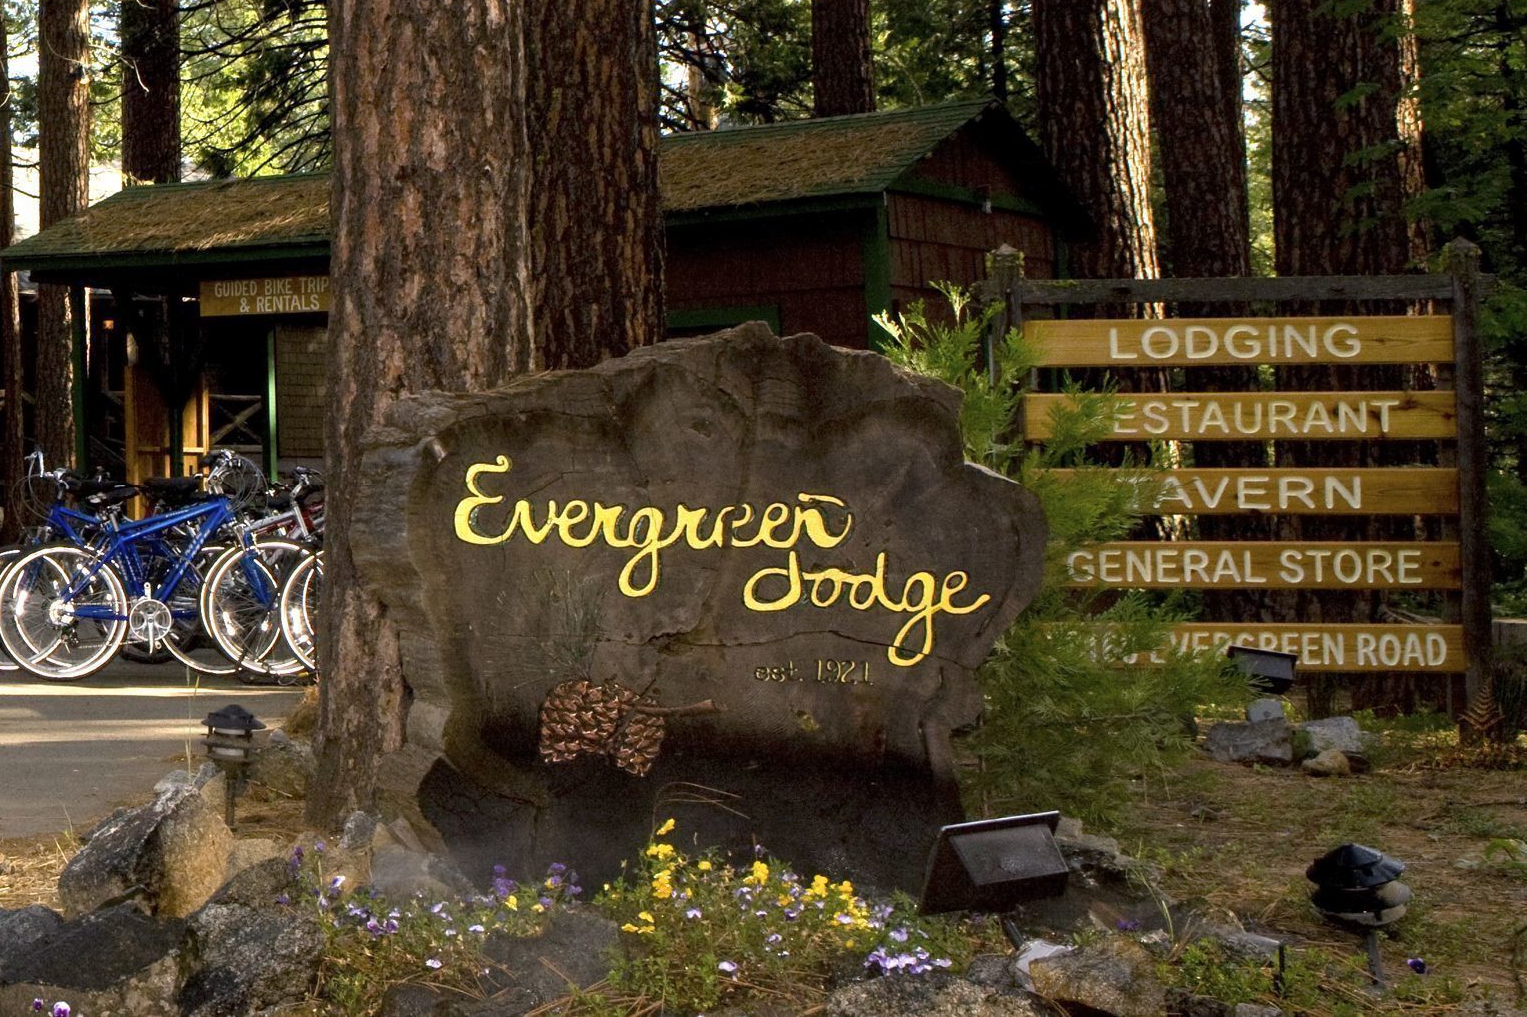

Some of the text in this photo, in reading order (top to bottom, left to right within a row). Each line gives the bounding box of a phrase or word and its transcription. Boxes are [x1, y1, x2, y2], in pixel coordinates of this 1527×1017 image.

[214, 280, 257, 297] GUIDED
[265, 278, 293, 295] BIKE
[239, 294, 320, 312] & RENTALS
[1109, 325, 1362, 359] LODGING
[1113, 401, 1400, 434] ESTAURANT
[454, 455, 852, 597] Evergreen
[1066, 549, 1424, 584] GENERAL STORE
[743, 552, 990, 667] Lodge
[1356, 632, 1447, 666] ROAD
[754, 659, 874, 685] est. 1921
